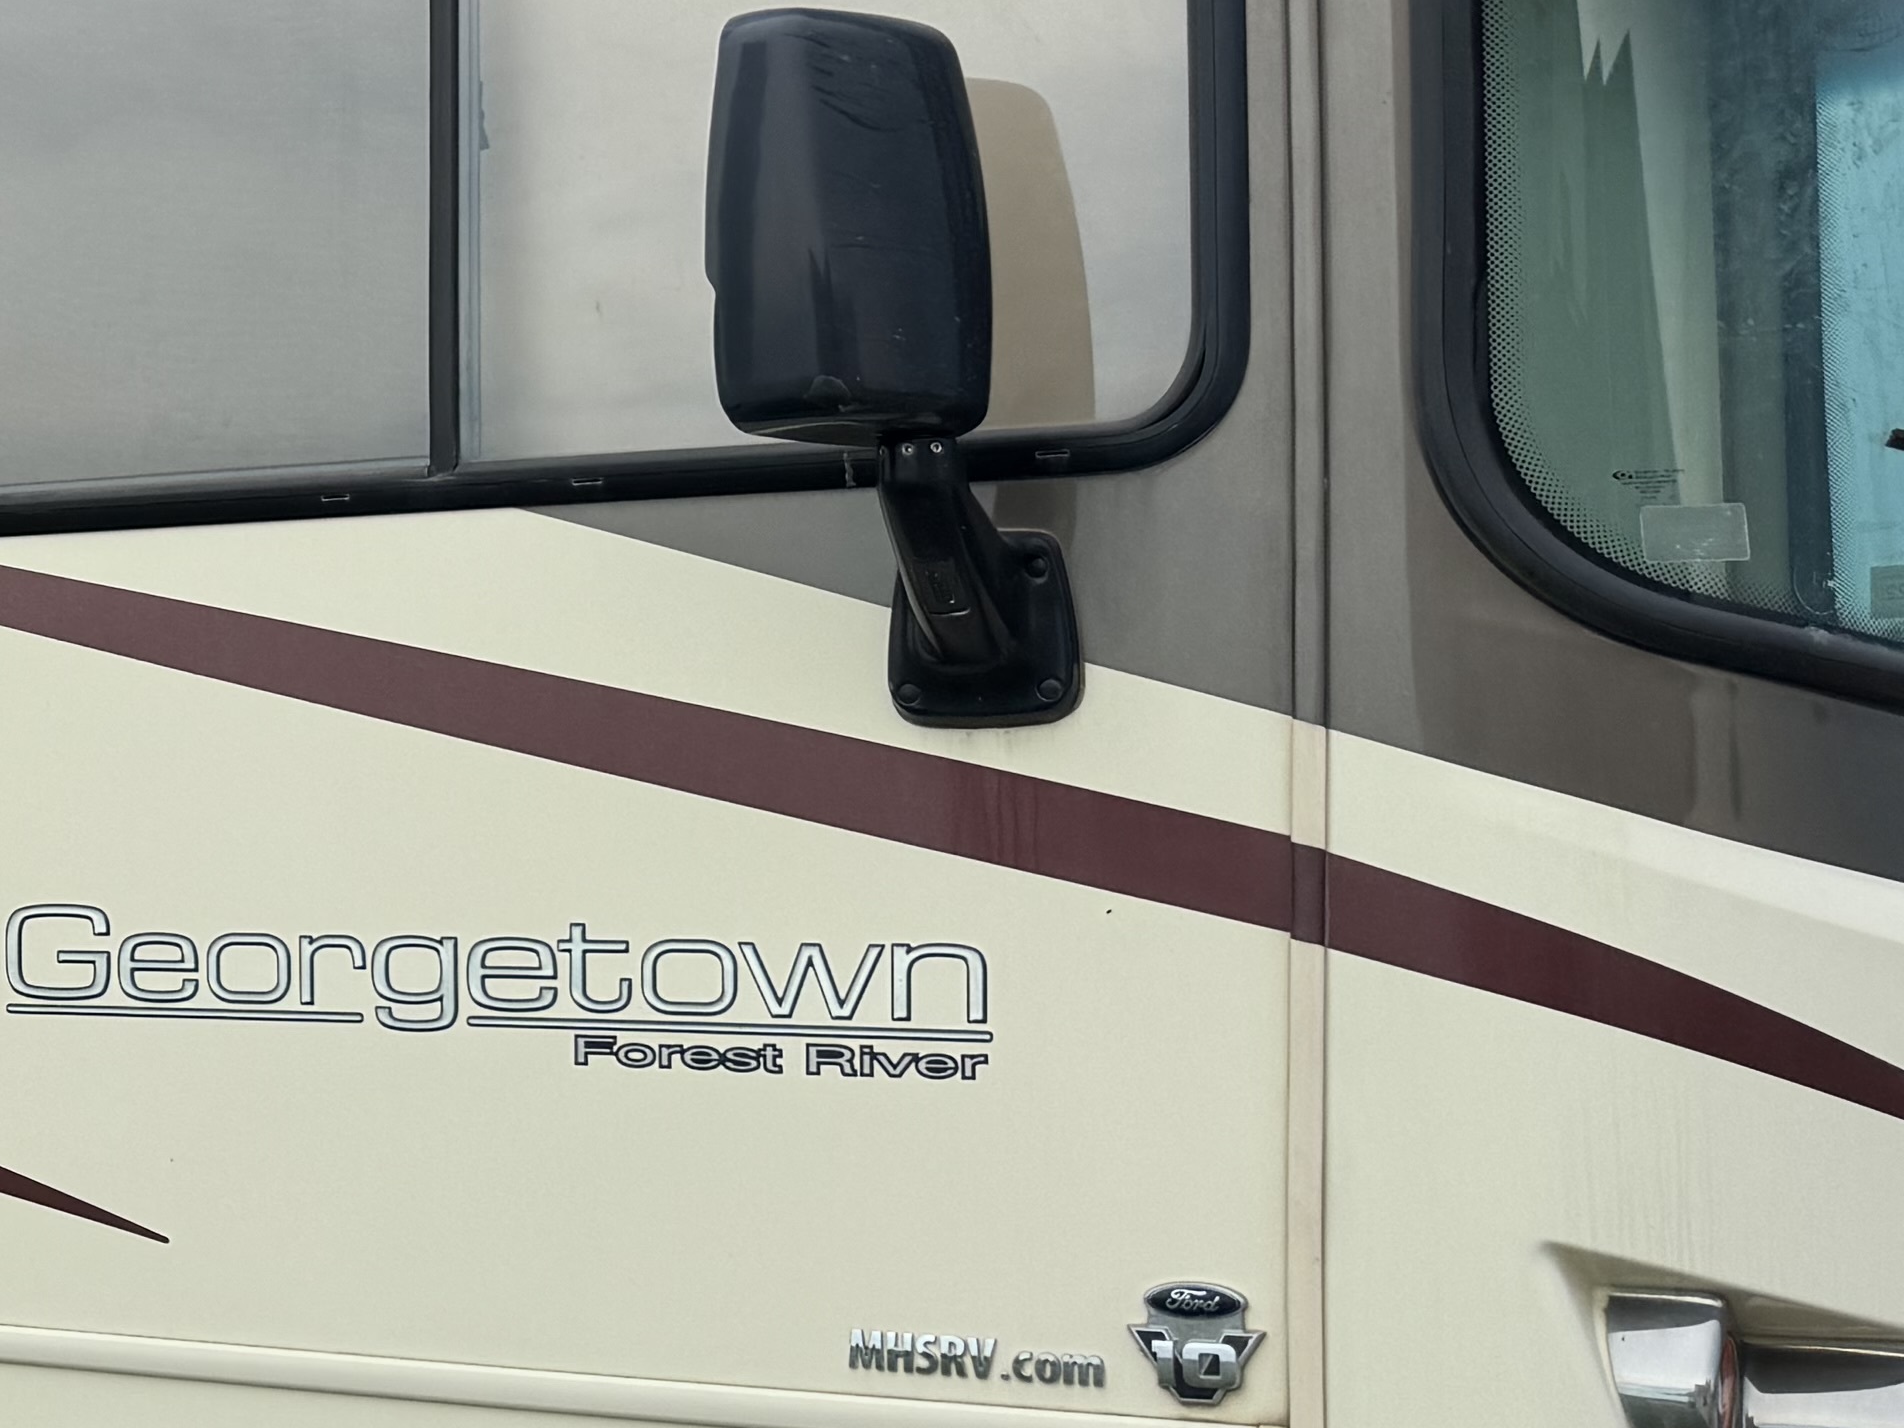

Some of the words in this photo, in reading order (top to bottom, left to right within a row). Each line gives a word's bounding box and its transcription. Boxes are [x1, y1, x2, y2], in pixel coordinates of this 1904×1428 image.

[4, 903, 988, 1033] Georgetown
[573, 1034, 784, 1074] Forest
[804, 1042, 990, 1081] River
[1165, 1288, 1221, 1313] Ford
